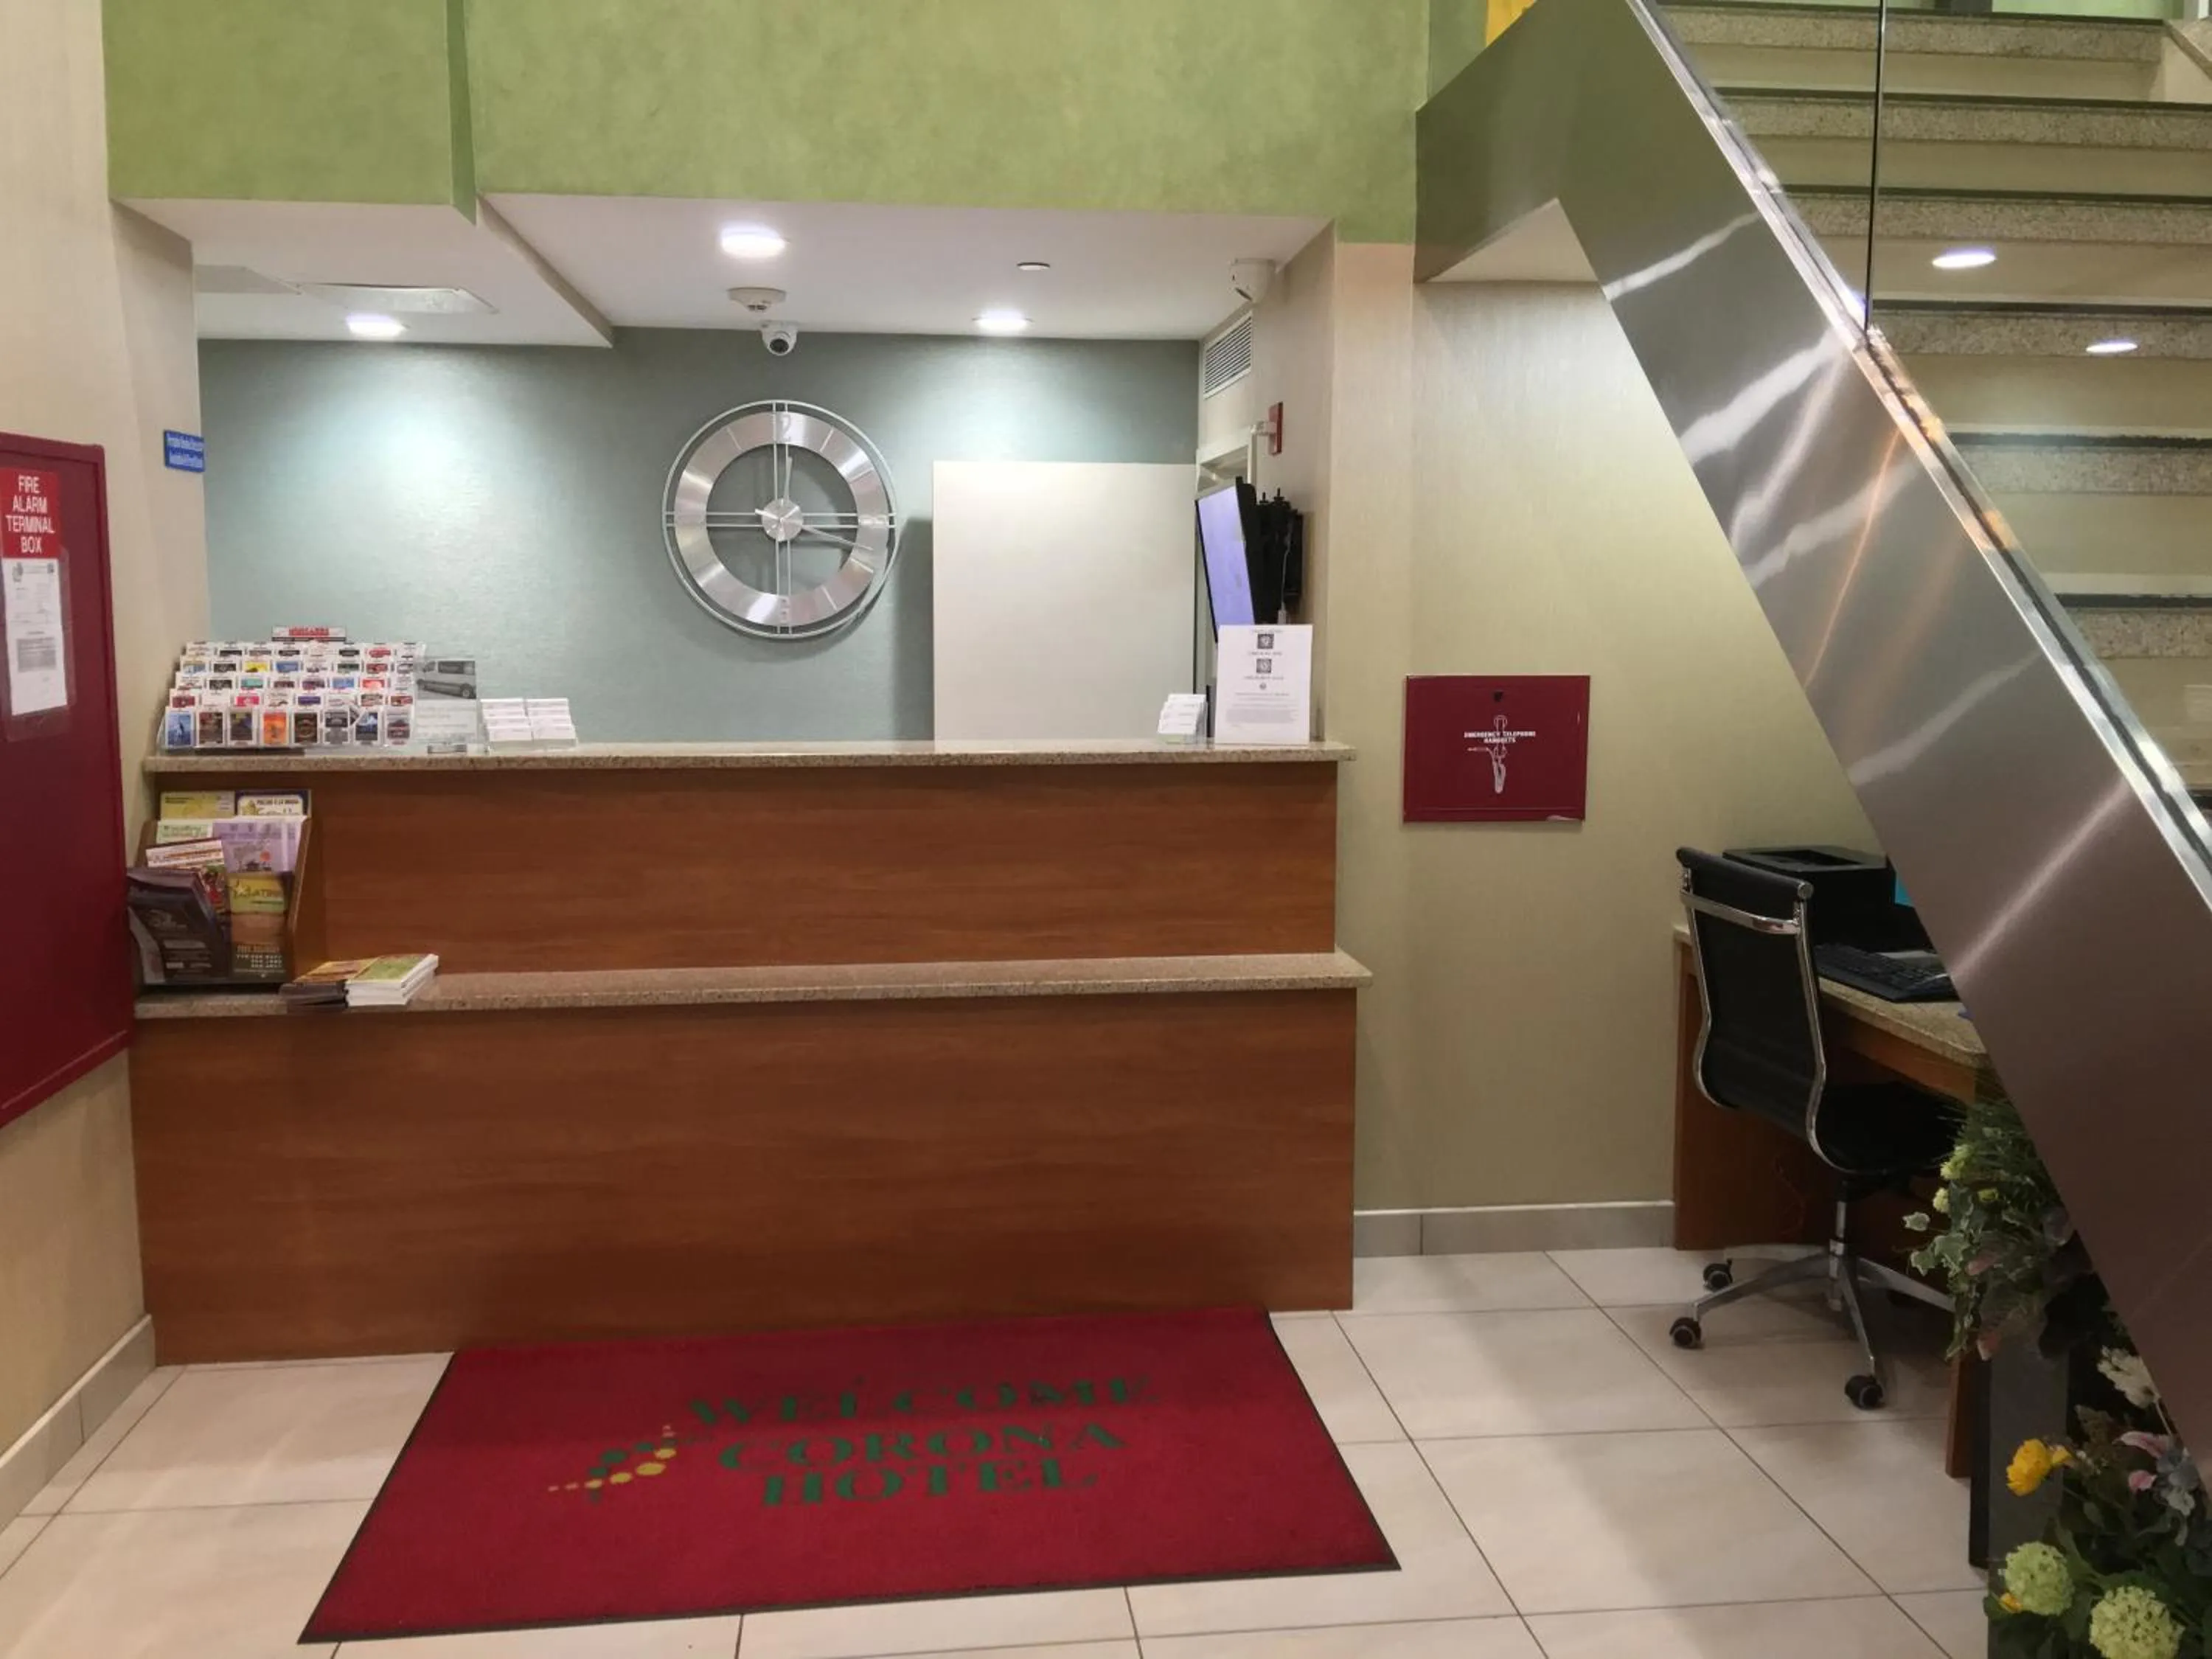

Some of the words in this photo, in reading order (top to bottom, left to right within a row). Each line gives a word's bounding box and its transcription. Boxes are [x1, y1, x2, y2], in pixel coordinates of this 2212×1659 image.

[18, 474, 41, 494] FIRE
[12, 495, 48, 514] ALARM
[5, 515, 55, 533] TERMINAL
[20, 535, 42, 554] BOX
[687, 1376, 1159, 1425] WELCOME
[719, 1423, 1127, 1468] CORONA
[762, 1457, 1102, 1506] HOTEL
